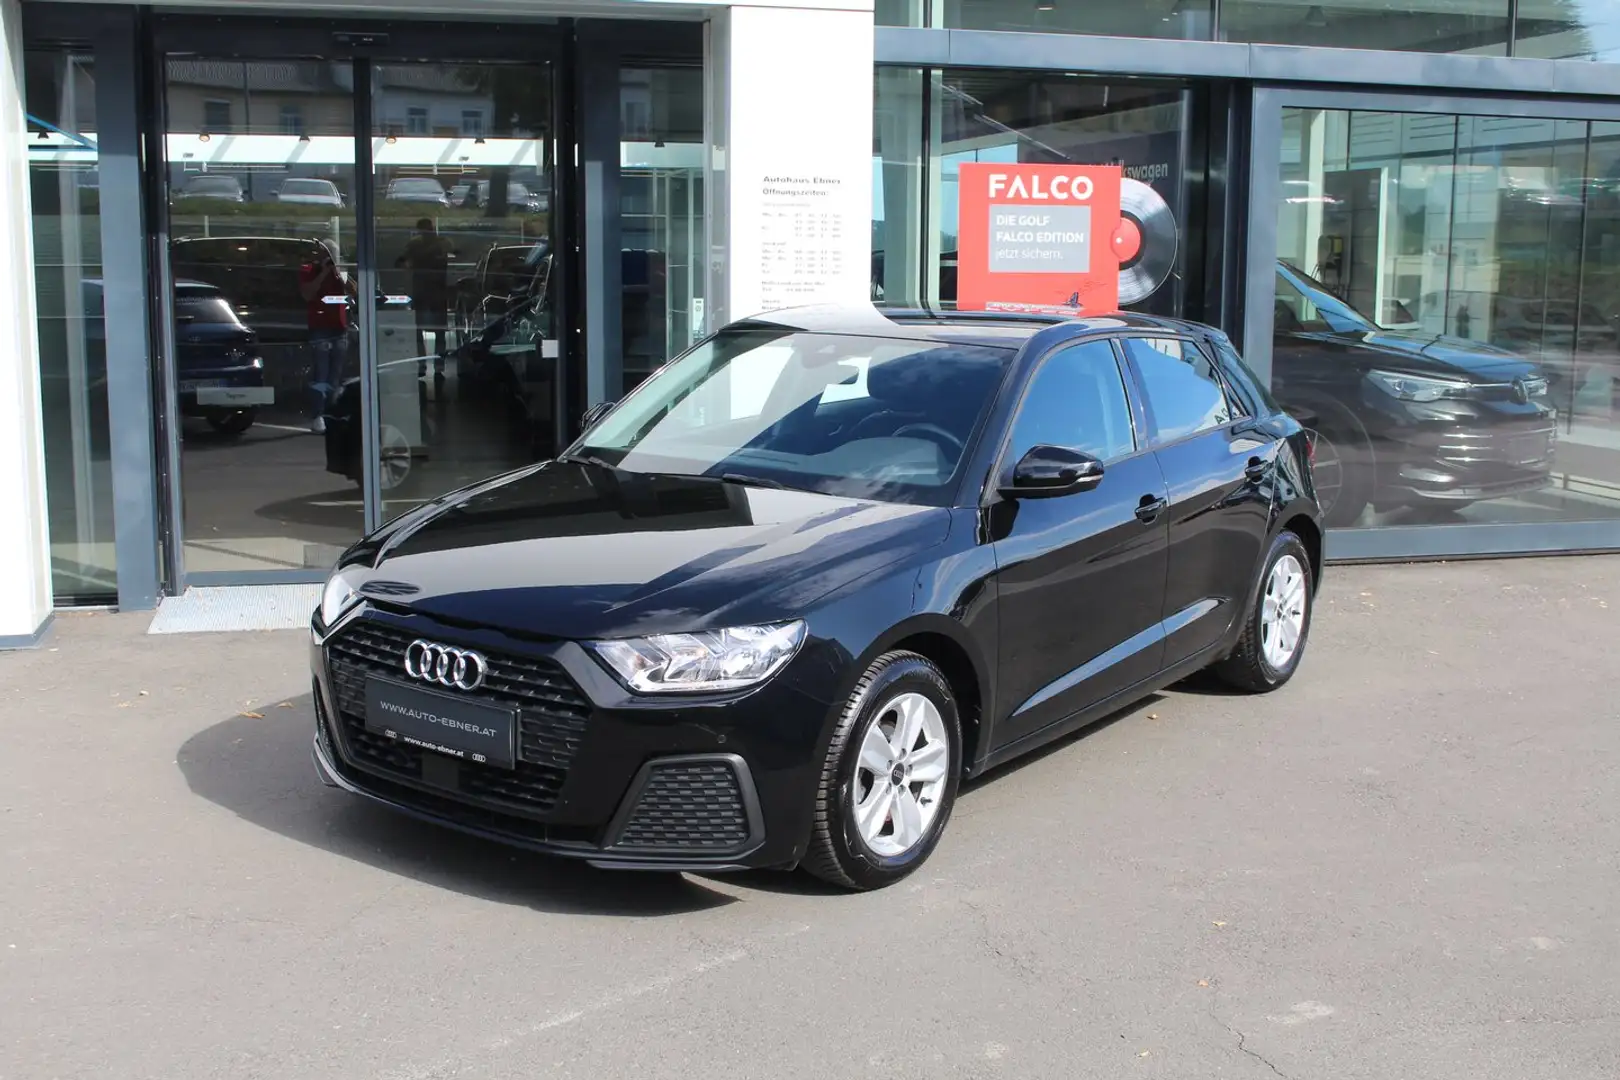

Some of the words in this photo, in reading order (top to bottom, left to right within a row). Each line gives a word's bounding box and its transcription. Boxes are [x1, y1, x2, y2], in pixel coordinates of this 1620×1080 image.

[763, 176, 810, 185] Autohaus
[988, 174, 1094, 200] FALCO
[996, 215, 1017, 226] DIE
[1018, 215, 1051, 227] GOLF
[996, 231, 1034, 243] FALCO
[1036, 232, 1084, 244] EDITION
[995, 248, 1018, 263] jetzt
[1021, 248, 1064, 260] sichern.
[379, 700, 497, 738] WWW.AUTO-EBNER.AT
[403, 736, 465, 758] www.auto-ebner.at
